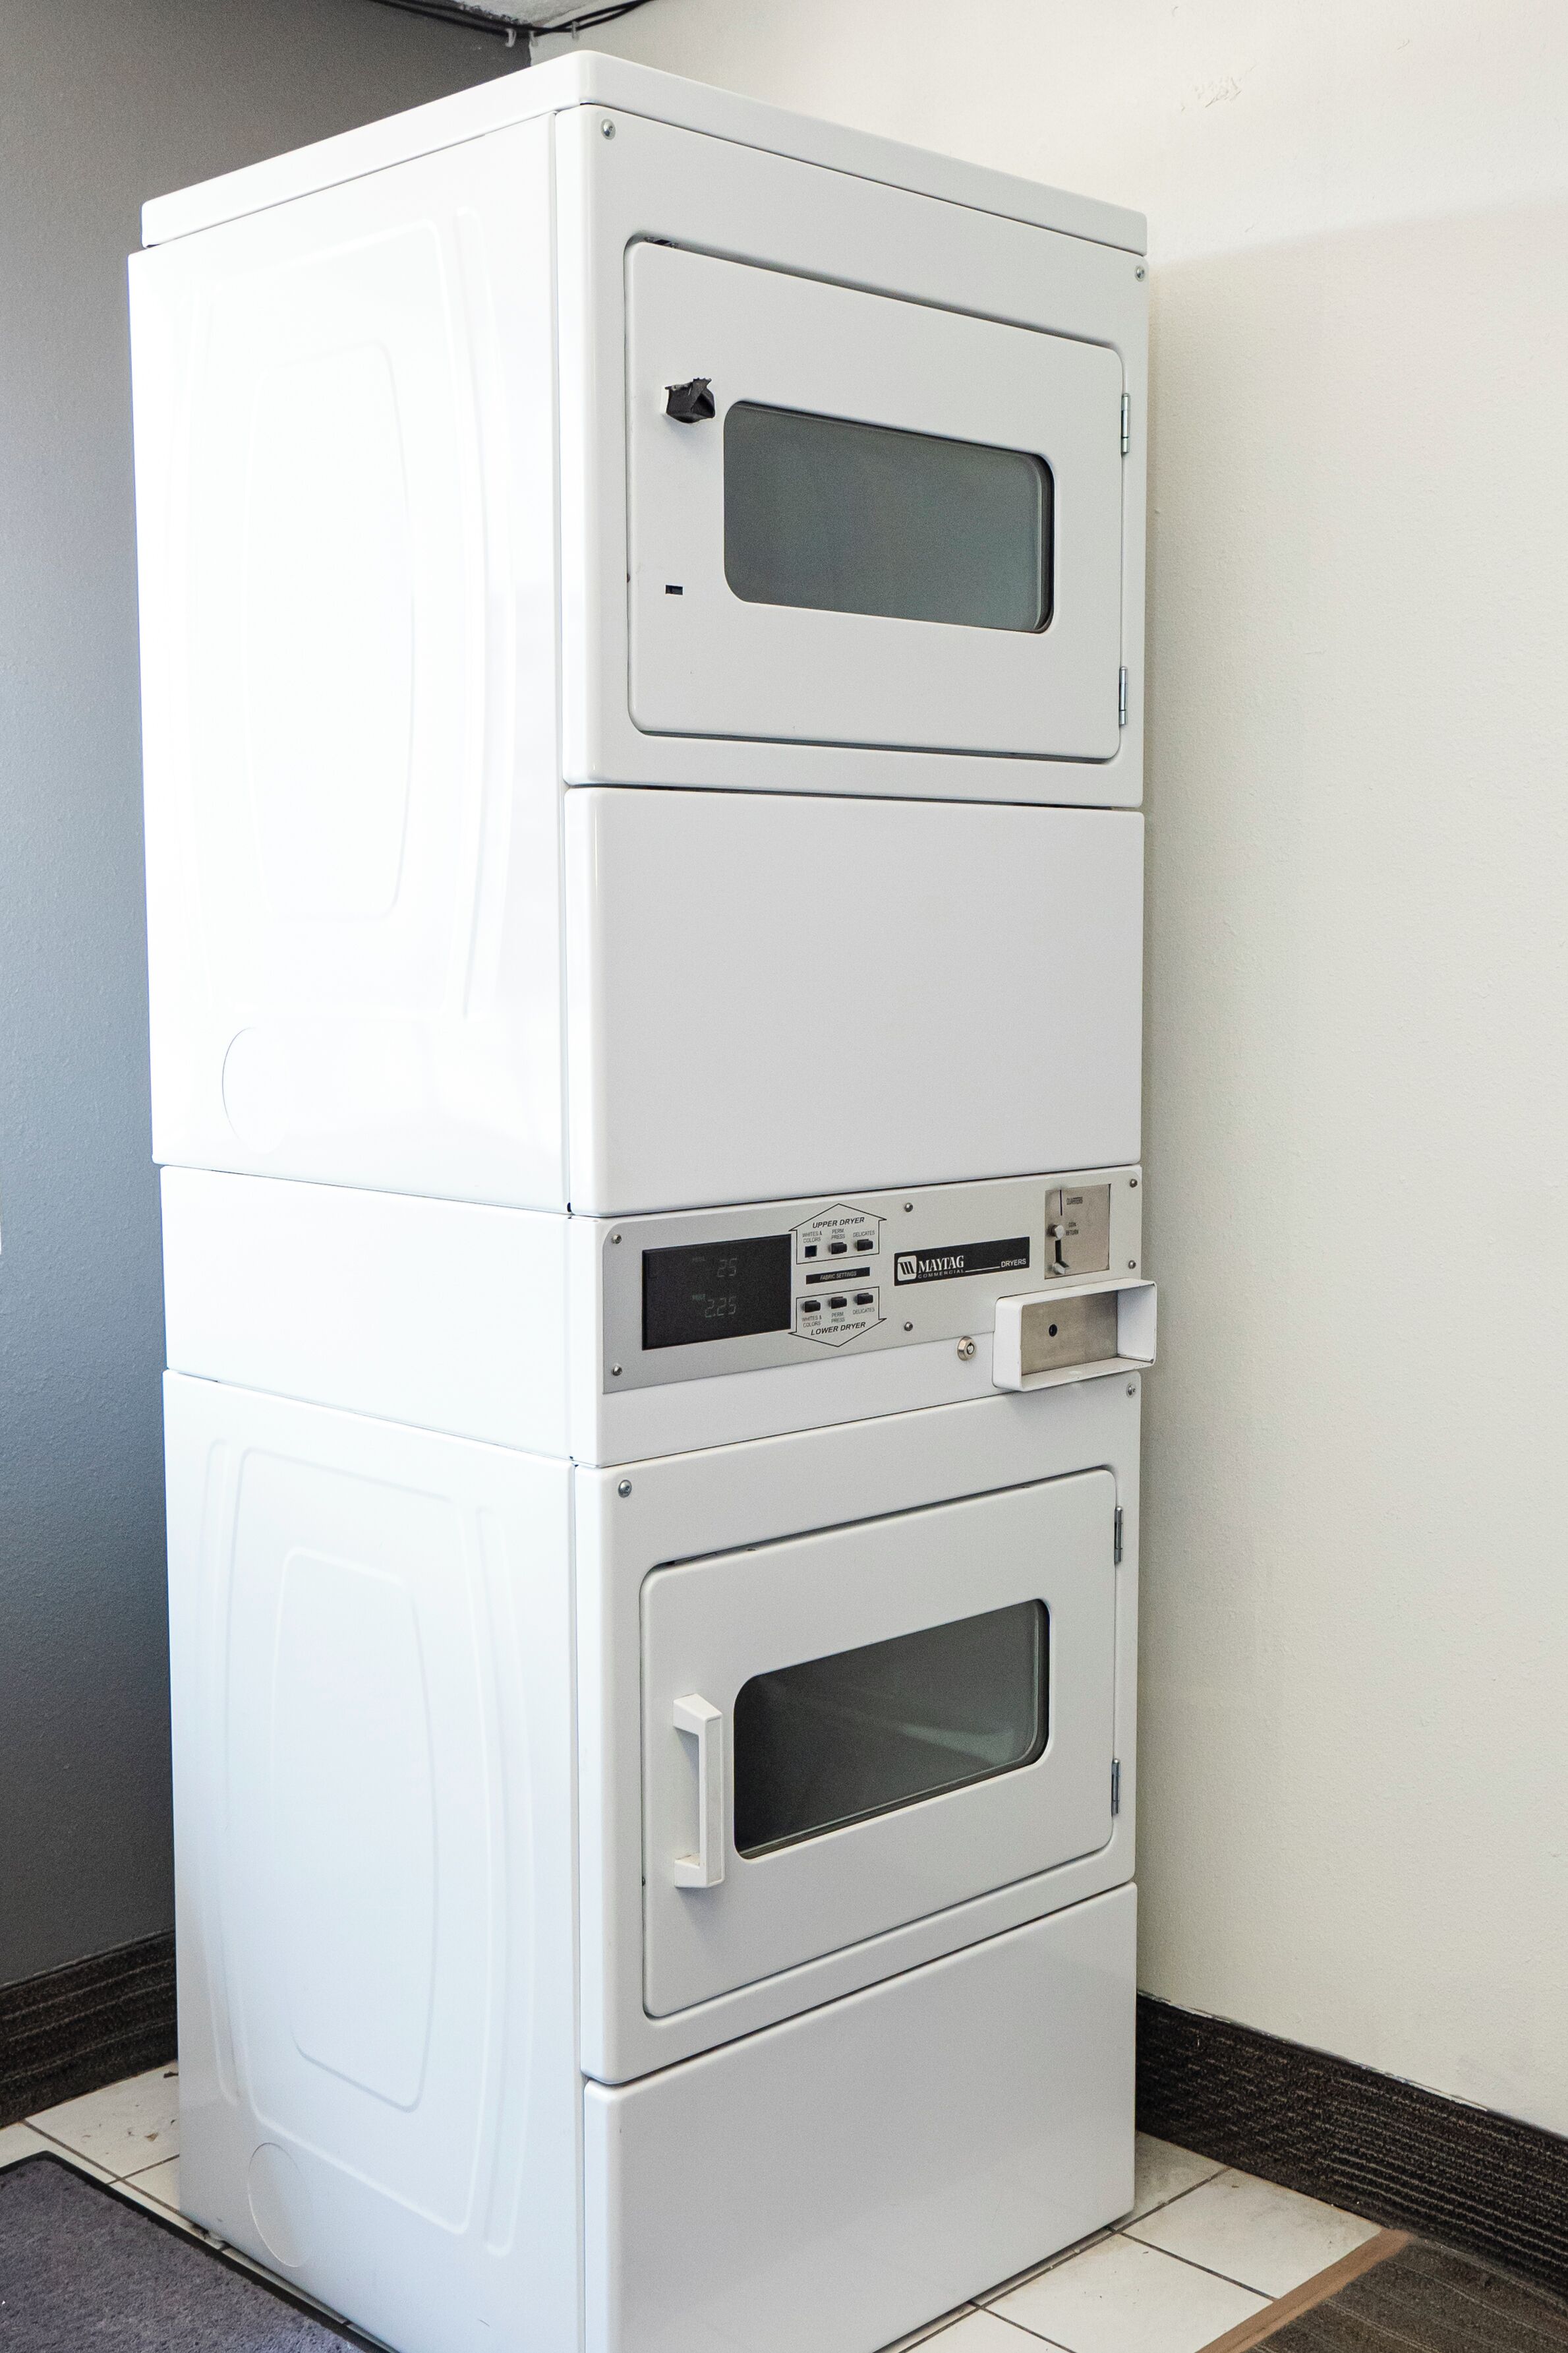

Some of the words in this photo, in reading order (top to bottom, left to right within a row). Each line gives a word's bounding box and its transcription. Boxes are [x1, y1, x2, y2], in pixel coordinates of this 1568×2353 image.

[813, 1220, 838, 1228] UPPER
[839, 1217, 865, 1226] DRYER
[918, 1255, 964, 1273] MAYTAG
[1001, 1259, 1026, 1268] DRYERS
[917, 1269, 965, 1279] COMMERCIAL
[811, 1326, 838, 1336] LOWER
[840, 1322, 866, 1331] DRYER
